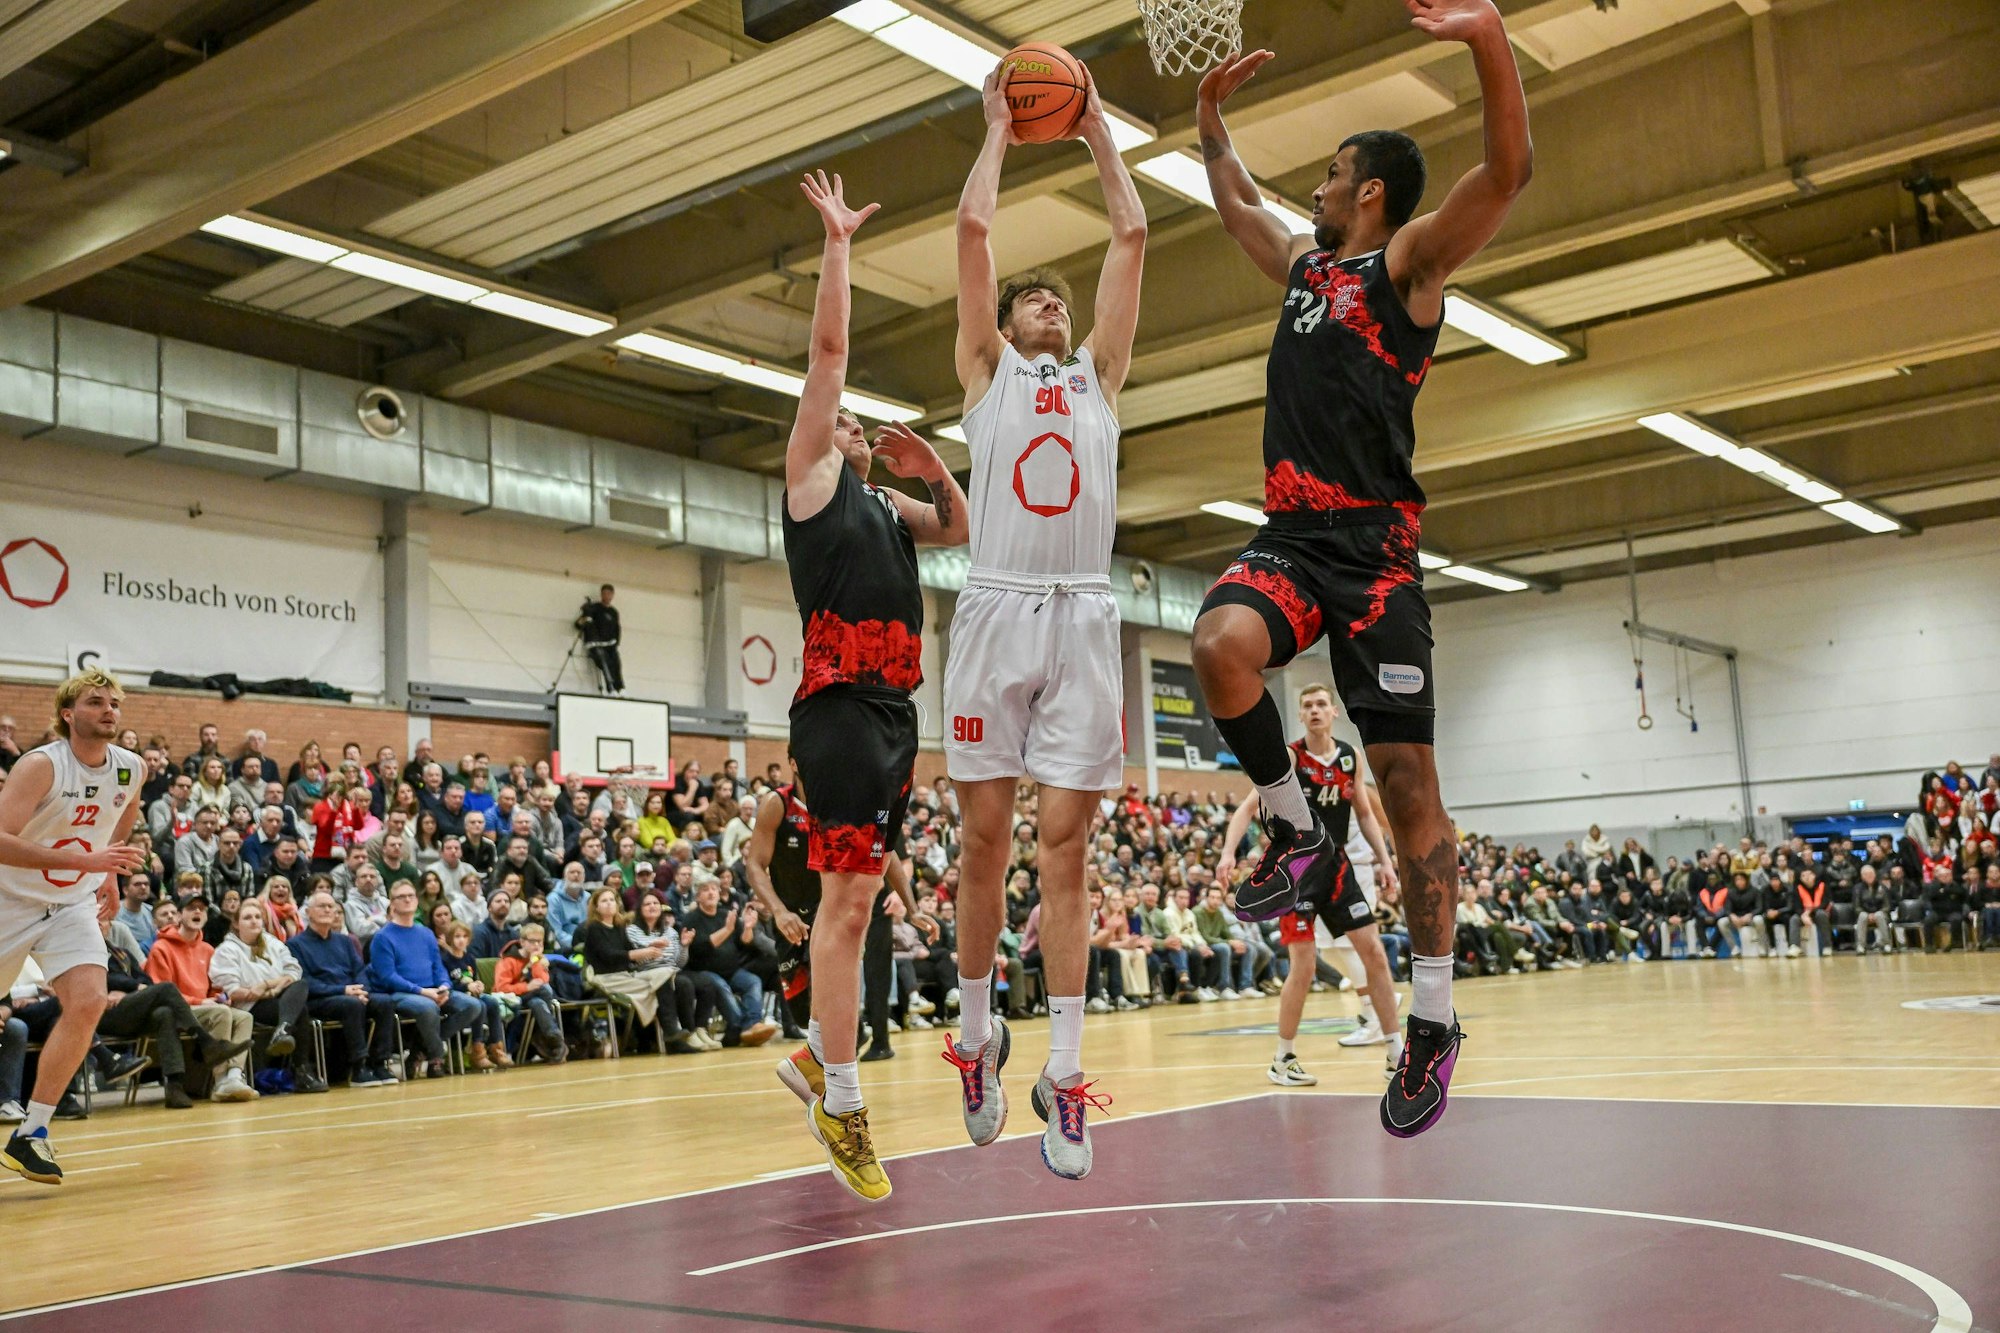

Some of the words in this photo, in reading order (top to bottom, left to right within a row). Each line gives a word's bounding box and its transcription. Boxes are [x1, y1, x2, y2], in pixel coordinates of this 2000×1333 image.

[1293, 291, 1327, 333] 24
[1035, 385, 1072, 416] 90
[103, 572, 227, 609] Flossbach
[234, 593, 277, 614] von
[284, 595, 357, 622] Storch
[1383, 671, 1420, 681] Barmenia
[953, 715, 983, 742] 90
[1317, 784, 1339, 806] 44
[71, 805, 100, 826] 22
